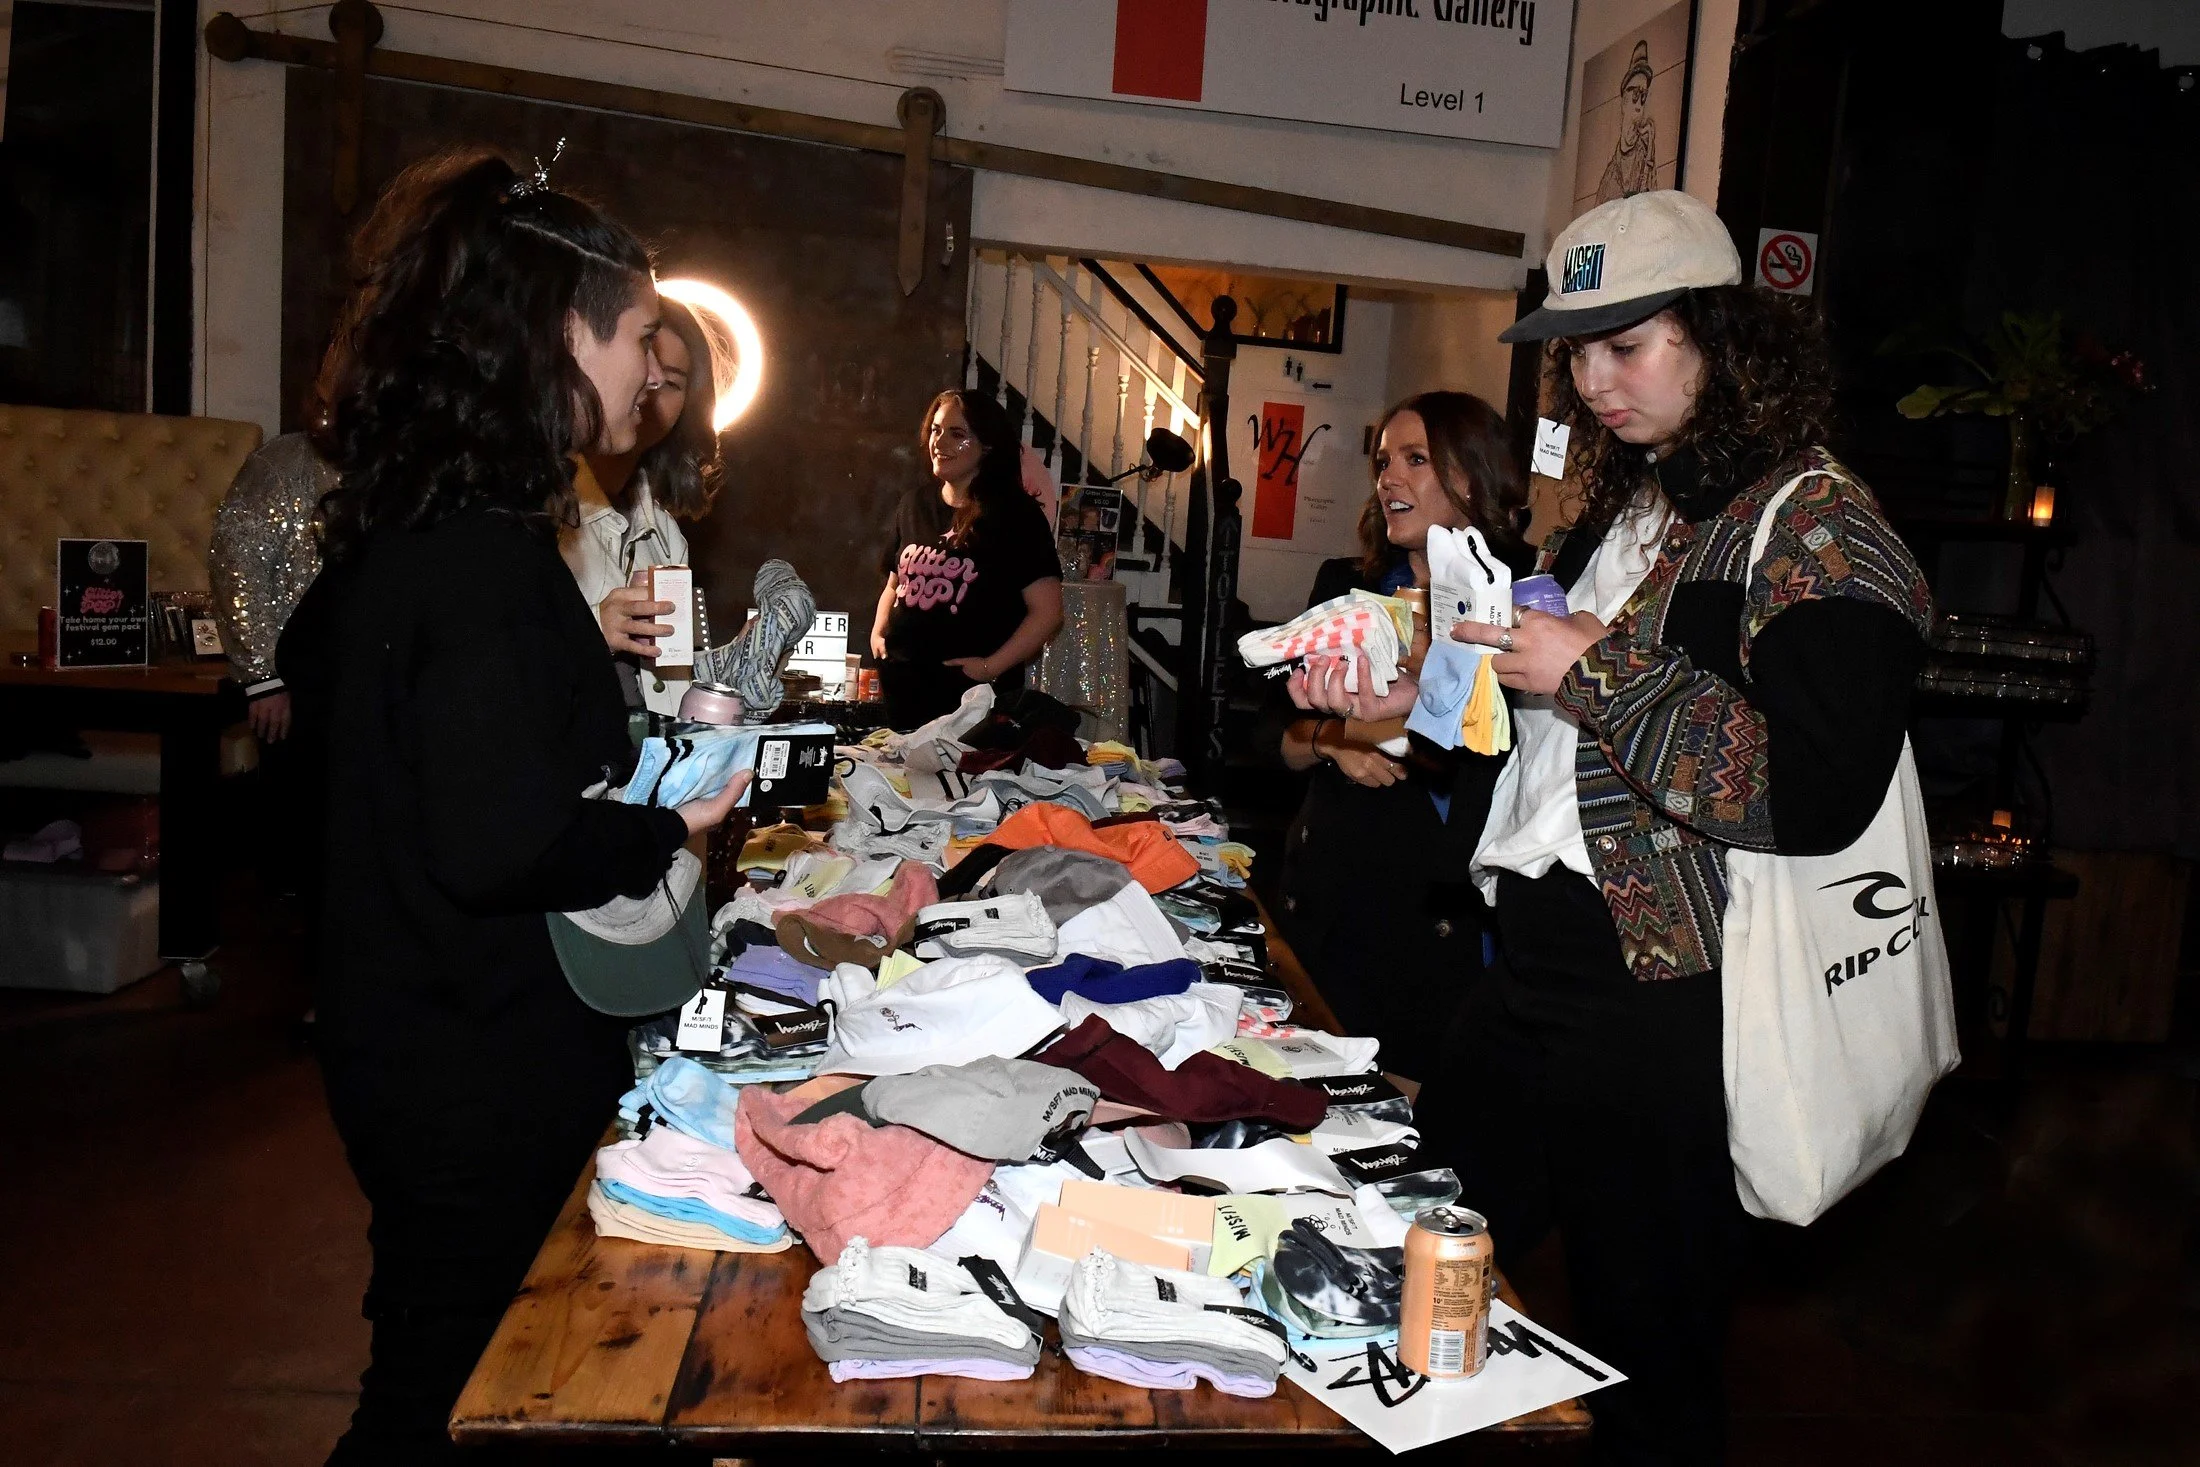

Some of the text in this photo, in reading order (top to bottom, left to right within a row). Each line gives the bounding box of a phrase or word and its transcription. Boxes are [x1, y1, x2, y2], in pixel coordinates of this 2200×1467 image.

[1400, 83, 1484, 113] Level 1
[60, 616, 81, 624] Take
[83, 616, 107, 624] home
[108, 617, 128, 625] your
[813, 617, 847, 632] TER
[65, 623, 141, 633] festival gem pack
[90, 638, 117, 646] $12.00
[794, 641, 814, 655] AR
[1825, 947, 1881, 998] RIP
[1062, 1086, 1078, 1098] MAD
